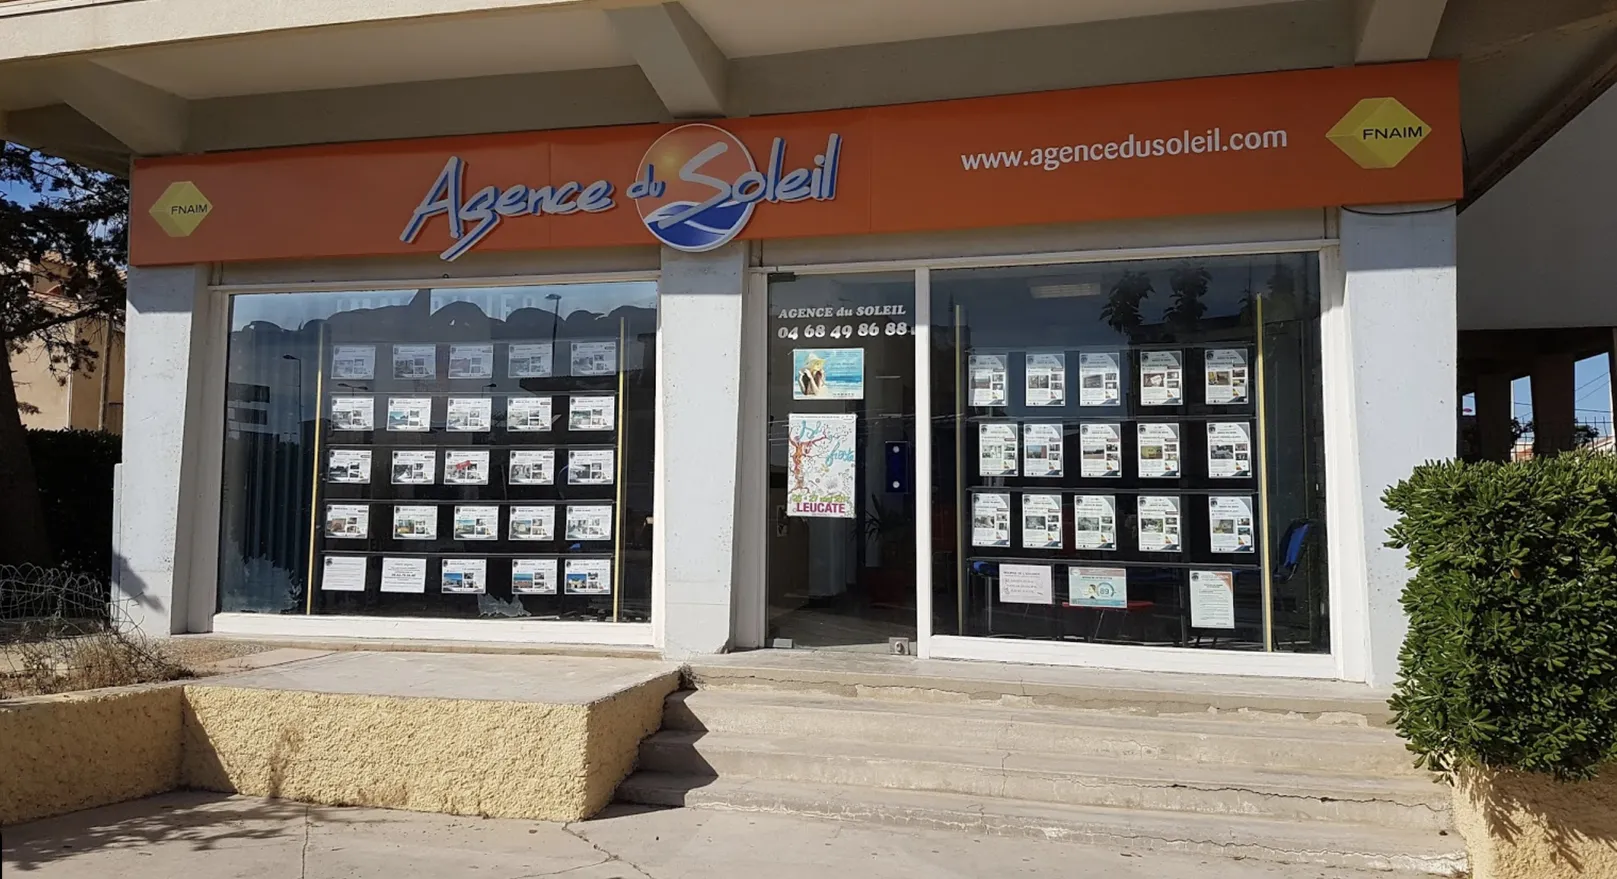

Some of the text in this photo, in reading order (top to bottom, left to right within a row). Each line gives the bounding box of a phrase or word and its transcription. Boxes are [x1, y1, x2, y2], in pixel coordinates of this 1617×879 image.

[1362, 126, 1423, 141] FNAIM
[960, 126, 1288, 172] www.agencedusoleil.com
[400, 133, 841, 261] Agence du Soleil
[171, 204, 208, 215] FNAIM
[779, 305, 907, 318] AGENCE du SOLEIL
[778, 322, 908, 340] 04 68 49 86 88
[796, 502, 846, 514] LEUCATE
